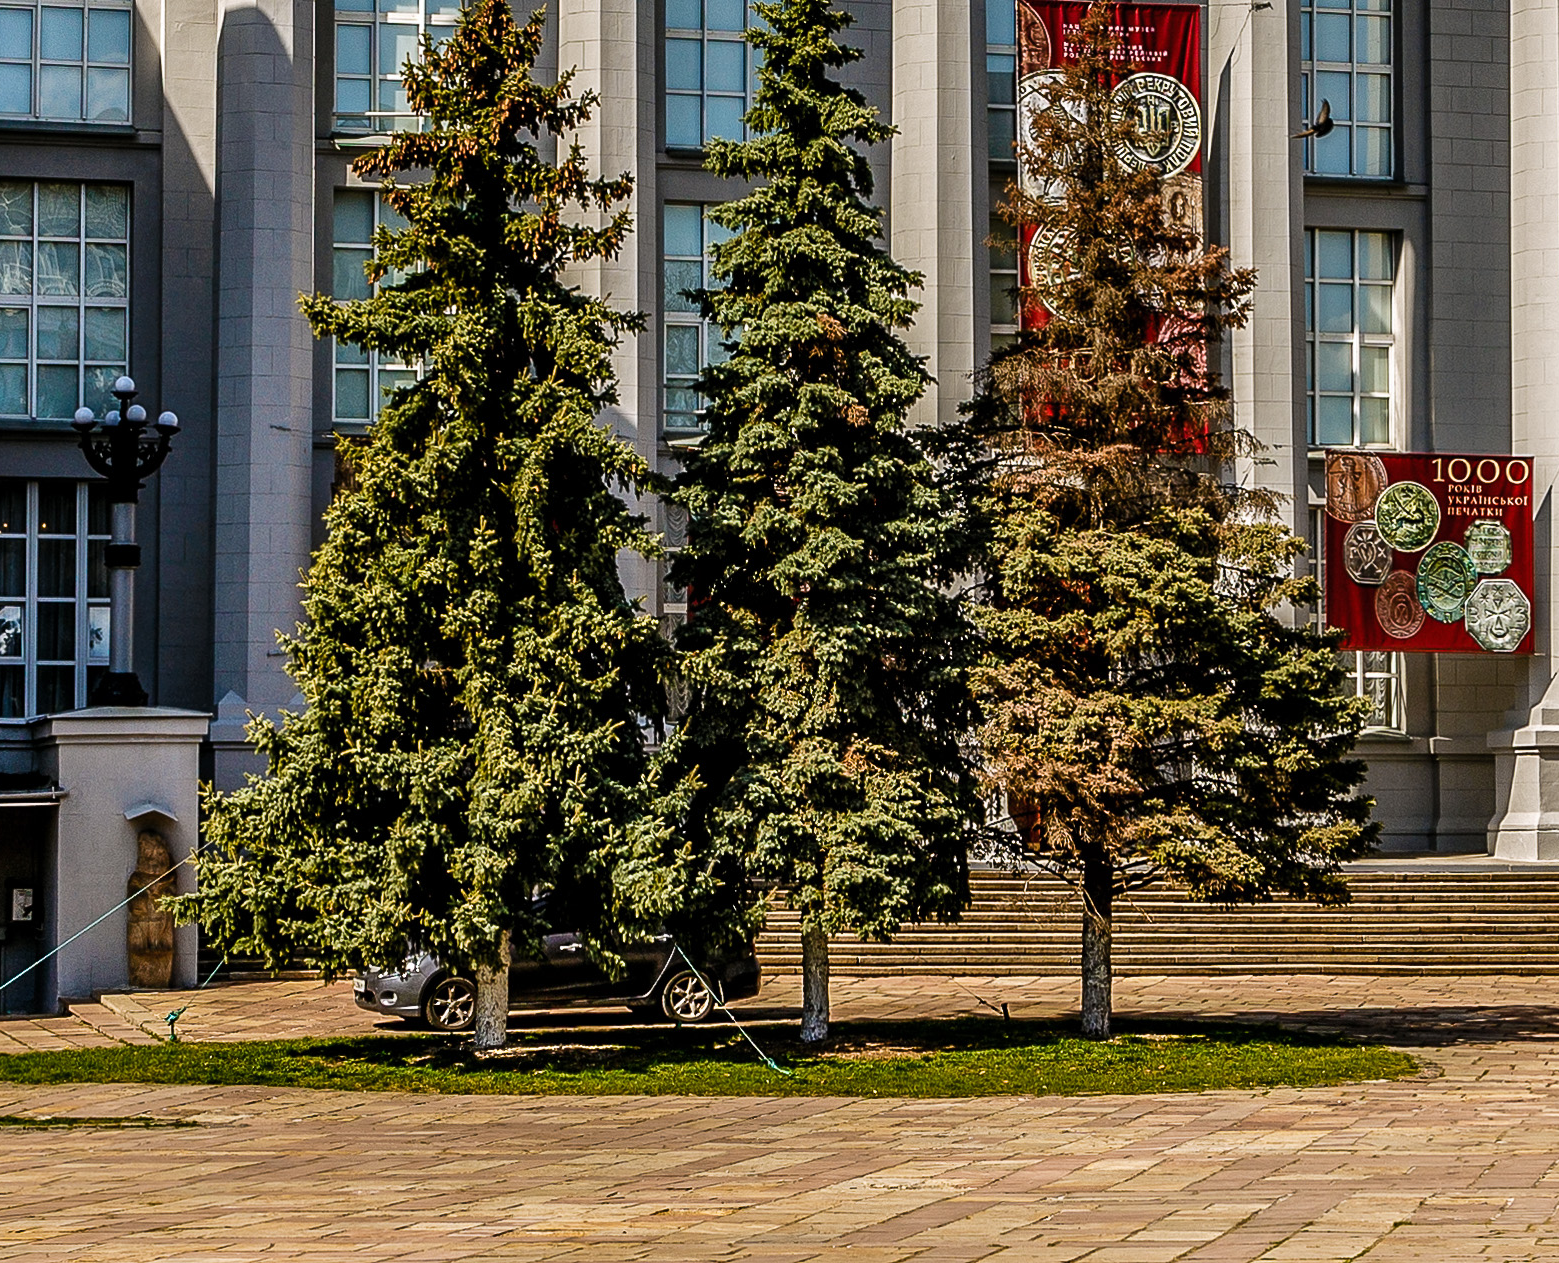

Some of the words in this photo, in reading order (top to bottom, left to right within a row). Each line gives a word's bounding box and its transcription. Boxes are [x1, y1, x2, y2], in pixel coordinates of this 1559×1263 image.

[1431, 457, 1530, 485] 1000
[1448, 484, 1483, 493] РОКІВ
[1447, 495, 1529, 506] УКРАЇНСЬКОЇ
[1447, 506, 1503, 517] ПЕЧАТКИ
